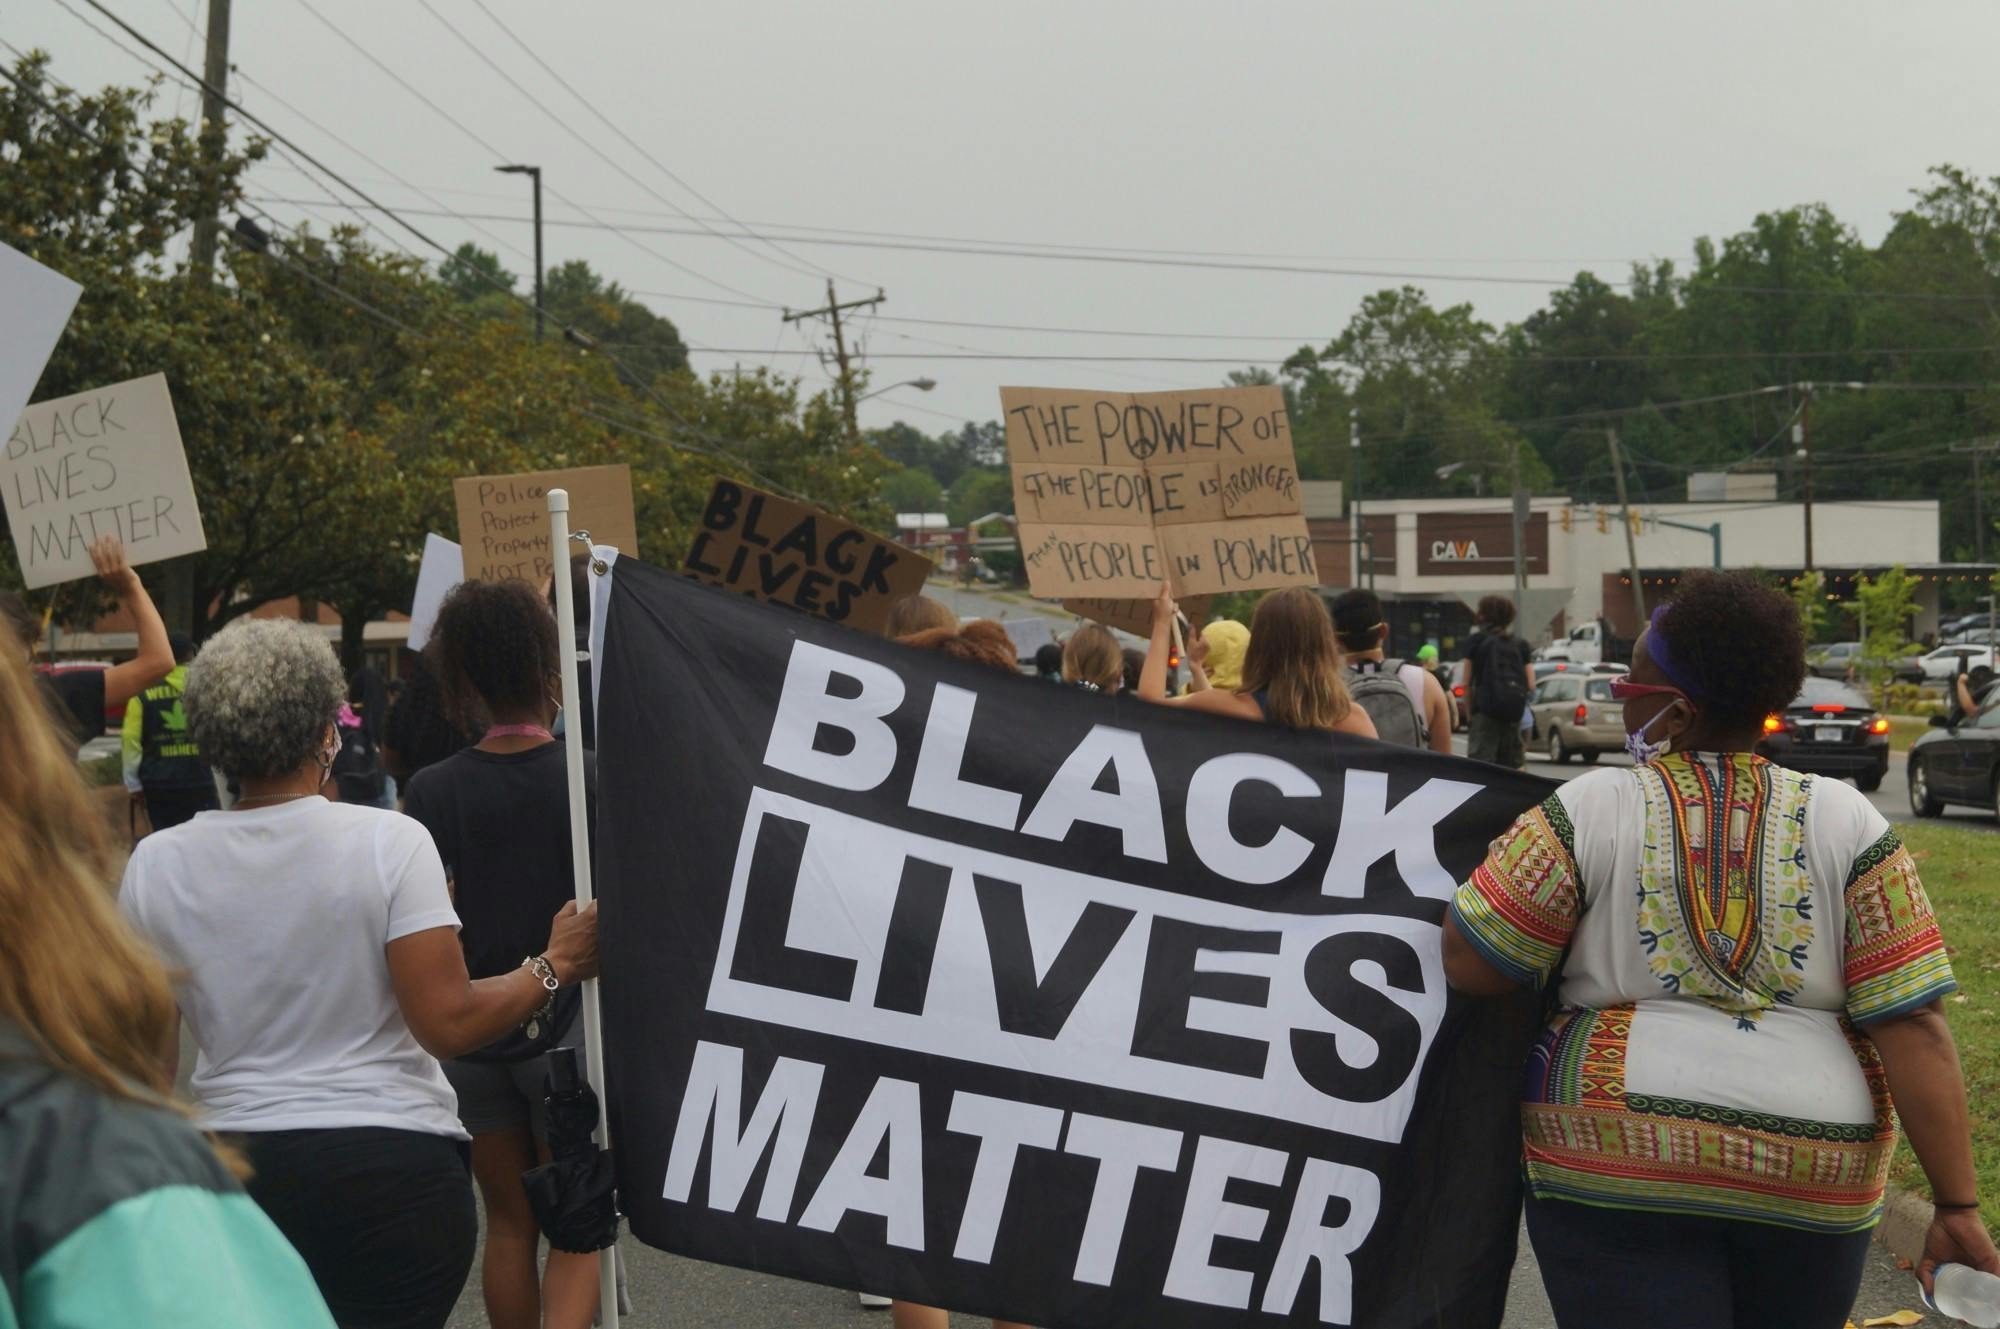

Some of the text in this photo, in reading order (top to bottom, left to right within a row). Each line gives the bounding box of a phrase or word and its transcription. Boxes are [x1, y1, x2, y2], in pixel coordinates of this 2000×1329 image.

[7, 398, 126, 460] BLACK
[1010, 401, 1288, 466] THE POWER OF
[15, 445, 117, 510] LIVES
[478, 482, 545, 506] Police
[1023, 463, 1296, 514] THE PEOPLE IS STRONGER
[30, 496, 181, 567] MATTER
[481, 511, 540, 533] Protect
[482, 535, 549, 557] Property
[703, 480, 899, 595] BLACK
[1431, 540, 1480, 560] CAVA
[481, 561, 526, 581] NOT
[685, 532, 863, 620] LIVES
[1027, 532, 1316, 586] THAN PEOPLE IN POWER
[763, 639, 1486, 901] BLACK
[728, 811, 1427, 1103] LIVES
[662, 1039, 1381, 1326] MATTER
